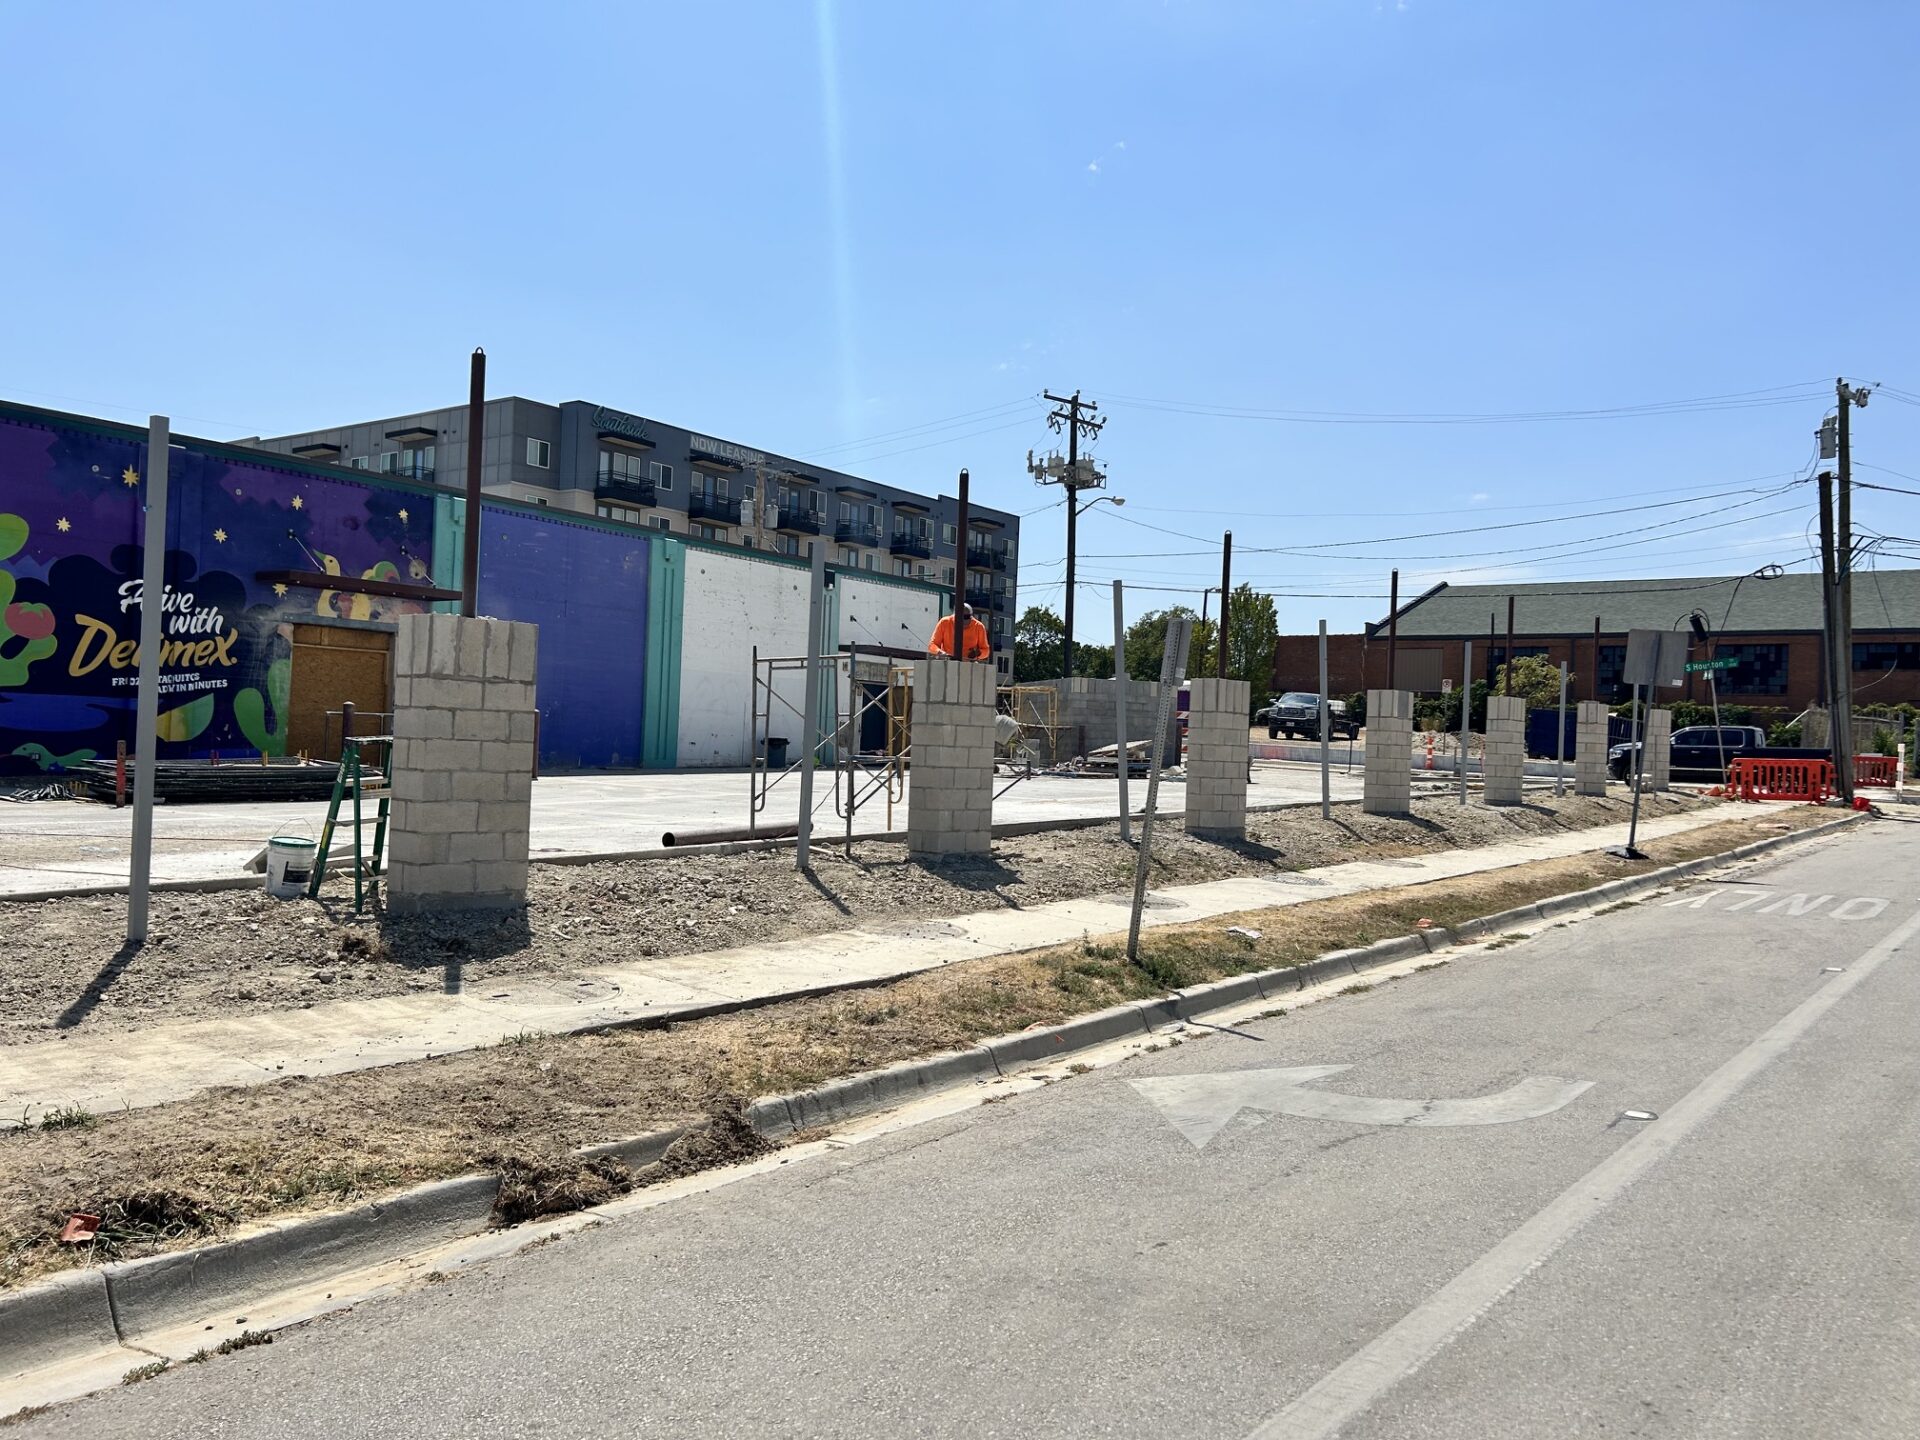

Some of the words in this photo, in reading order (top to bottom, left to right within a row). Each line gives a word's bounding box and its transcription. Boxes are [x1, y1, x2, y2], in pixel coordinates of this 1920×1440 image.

[592, 406, 649, 439] Southside
[690, 434, 717, 453] NOW
[720, 443, 765, 463] LEASING
[118, 579, 194, 613] Aive
[169, 606, 224, 634] with
[69, 613, 238, 677] Demex.
[112, 677, 139, 687] FROZ
[188, 680, 228, 691] MINUTES
[1659, 888, 1891, 920] ONLY
